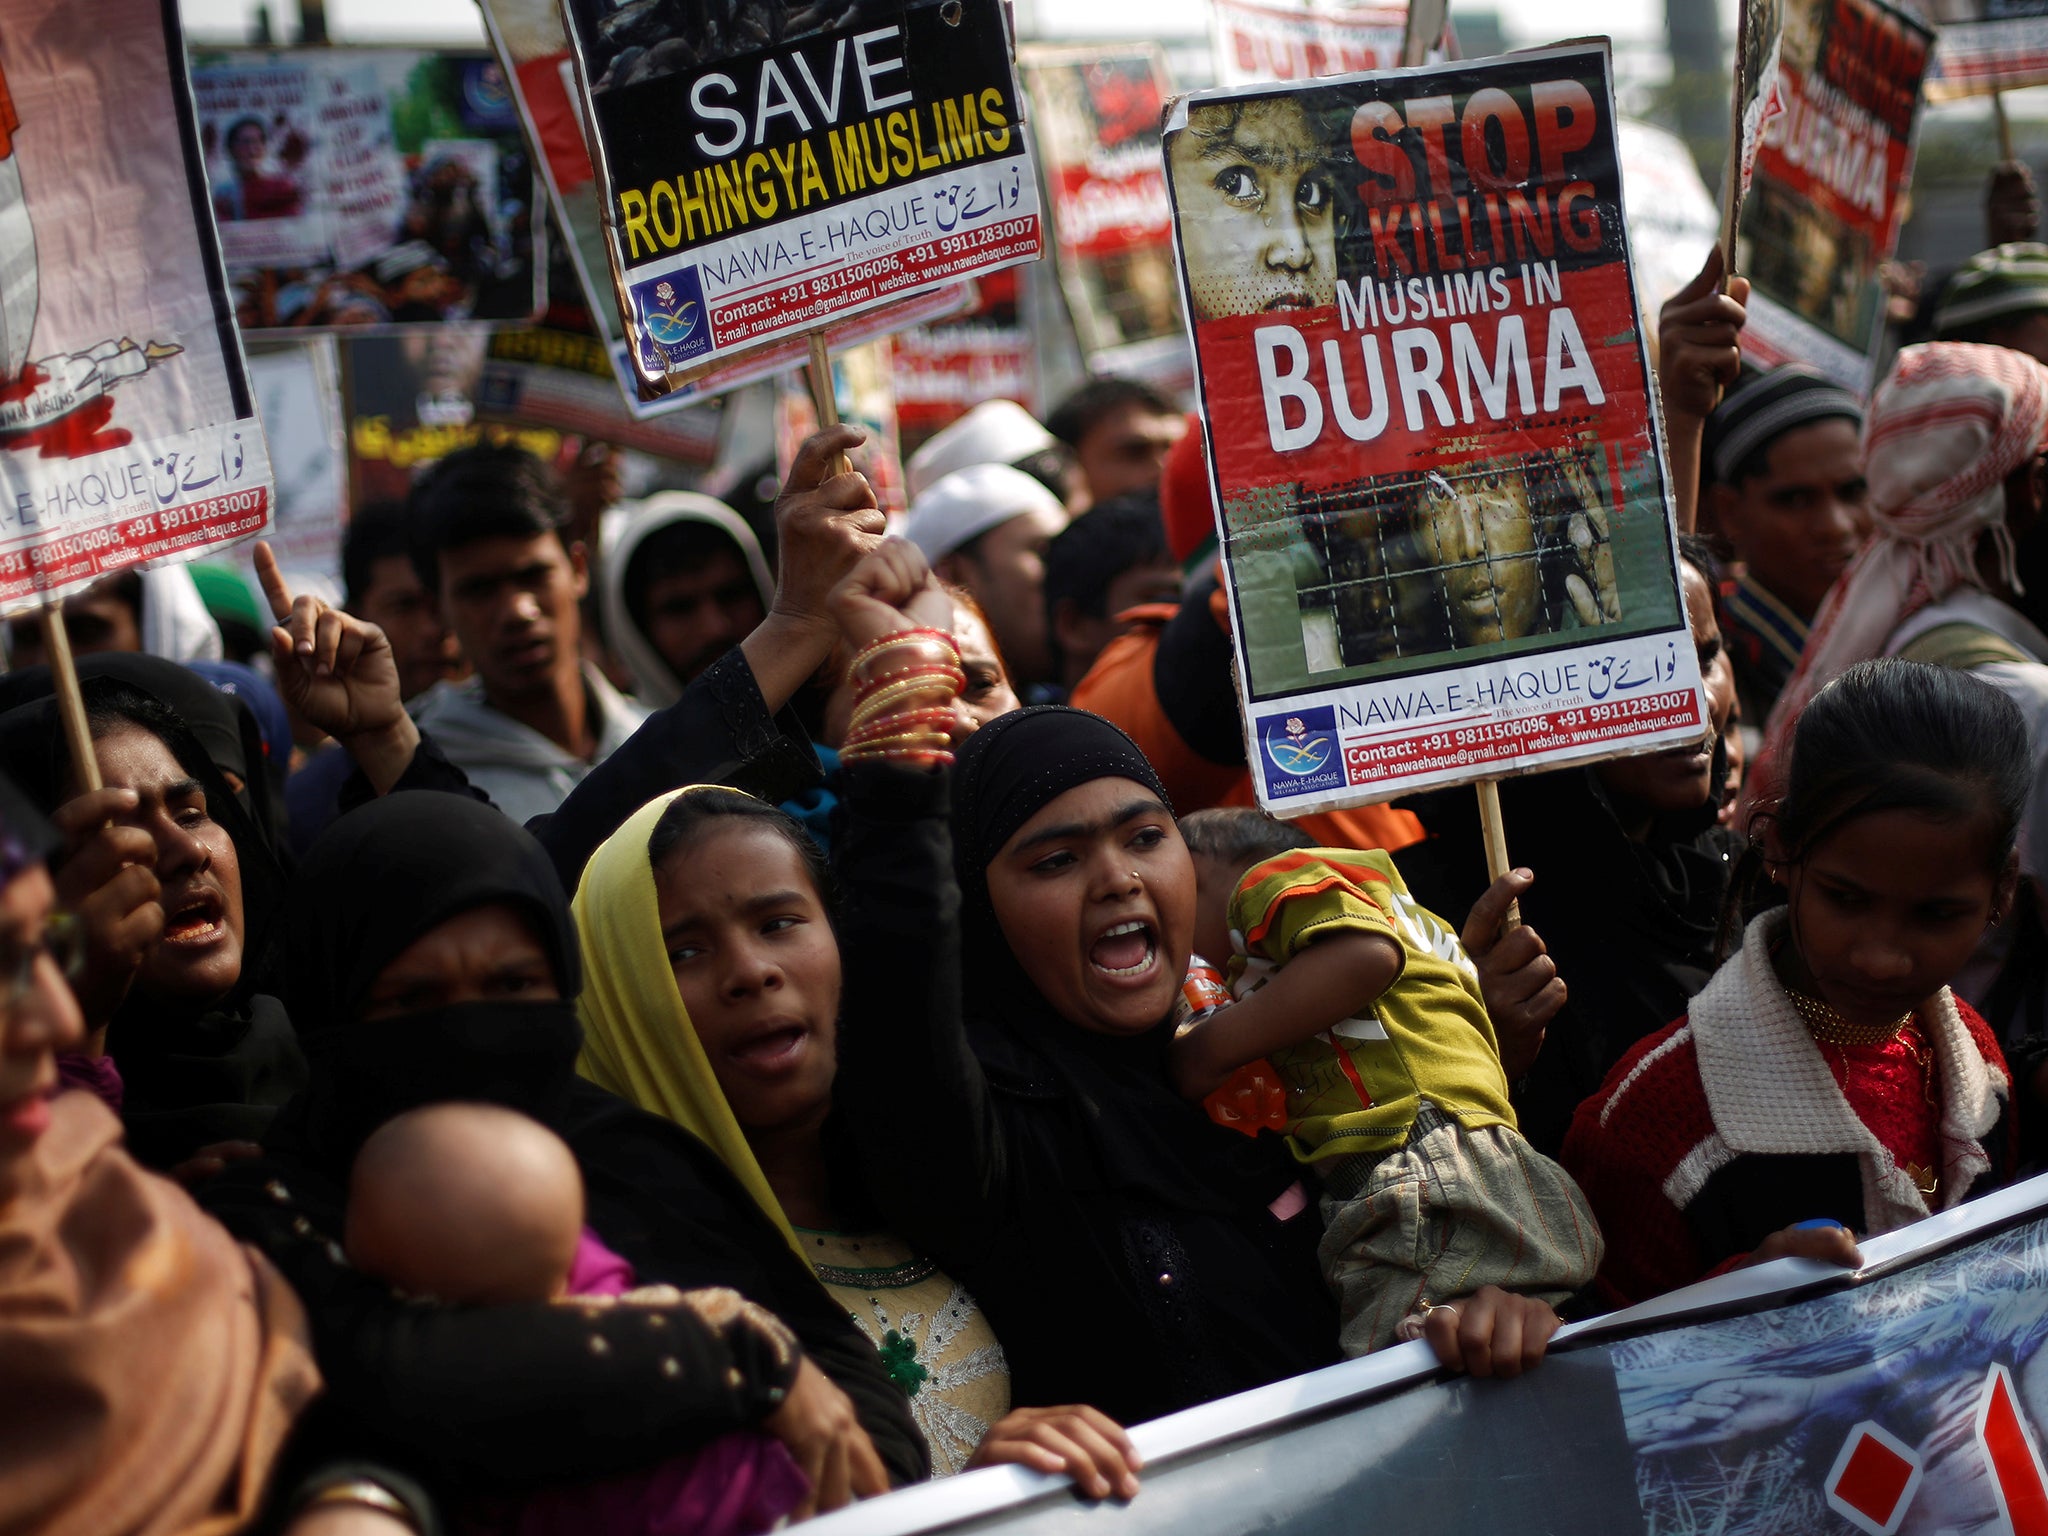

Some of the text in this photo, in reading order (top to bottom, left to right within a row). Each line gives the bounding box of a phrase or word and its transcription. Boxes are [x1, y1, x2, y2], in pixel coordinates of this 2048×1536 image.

[689, 25, 913, 158] SAVE
[619, 141, 831, 260] ROHINGYA
[827, 87, 1012, 196] MUSLIMS
[1350, 79, 1598, 207] STOP
[702, 196, 928, 291] NAWA-E-HAQUE
[845, 229, 934, 263] The voice of Truth
[1368, 181, 1602, 279] KILLING
[713, 217, 1034, 326] Contact: +91 9811506096, +91 9911283007
[716, 324, 750, 345] E-mail:
[751, 285, 870, 335] nawaehaque@gmail.com
[878, 271, 921, 293] website:
[922, 238, 1038, 280] www.nawaehaque.com
[1335, 259, 1563, 332] MUSLIMS IN
[1253, 306, 1606, 453] BURMA
[0, 463, 147, 531] -E-HAQUE
[30, 526, 126, 568] 9811506096,
[126, 516, 157, 538] +91
[159, 490, 260, 530] 9911283007
[98, 546, 141, 568] website:
[142, 513, 261, 557] www.nawaehaque.com
[1338, 663, 1580, 731] NAWA-E-HAQUE
[1348, 690, 1690, 764] Contact: +91 9811506096, +91 9911283007
[1495, 694, 1584, 719] The voice of Truth
[1273, 771, 1339, 791] NAWA-E-HAQUE
[1350, 763, 1389, 782] E-mail:
[1389, 742, 1519, 778] nawaehaque@gmail.com
[1527, 733, 1571, 752] website:
[1571, 710, 1693, 743] www.nawaehaque.com
[1300, 780, 1340, 792] ASSOCIATION
